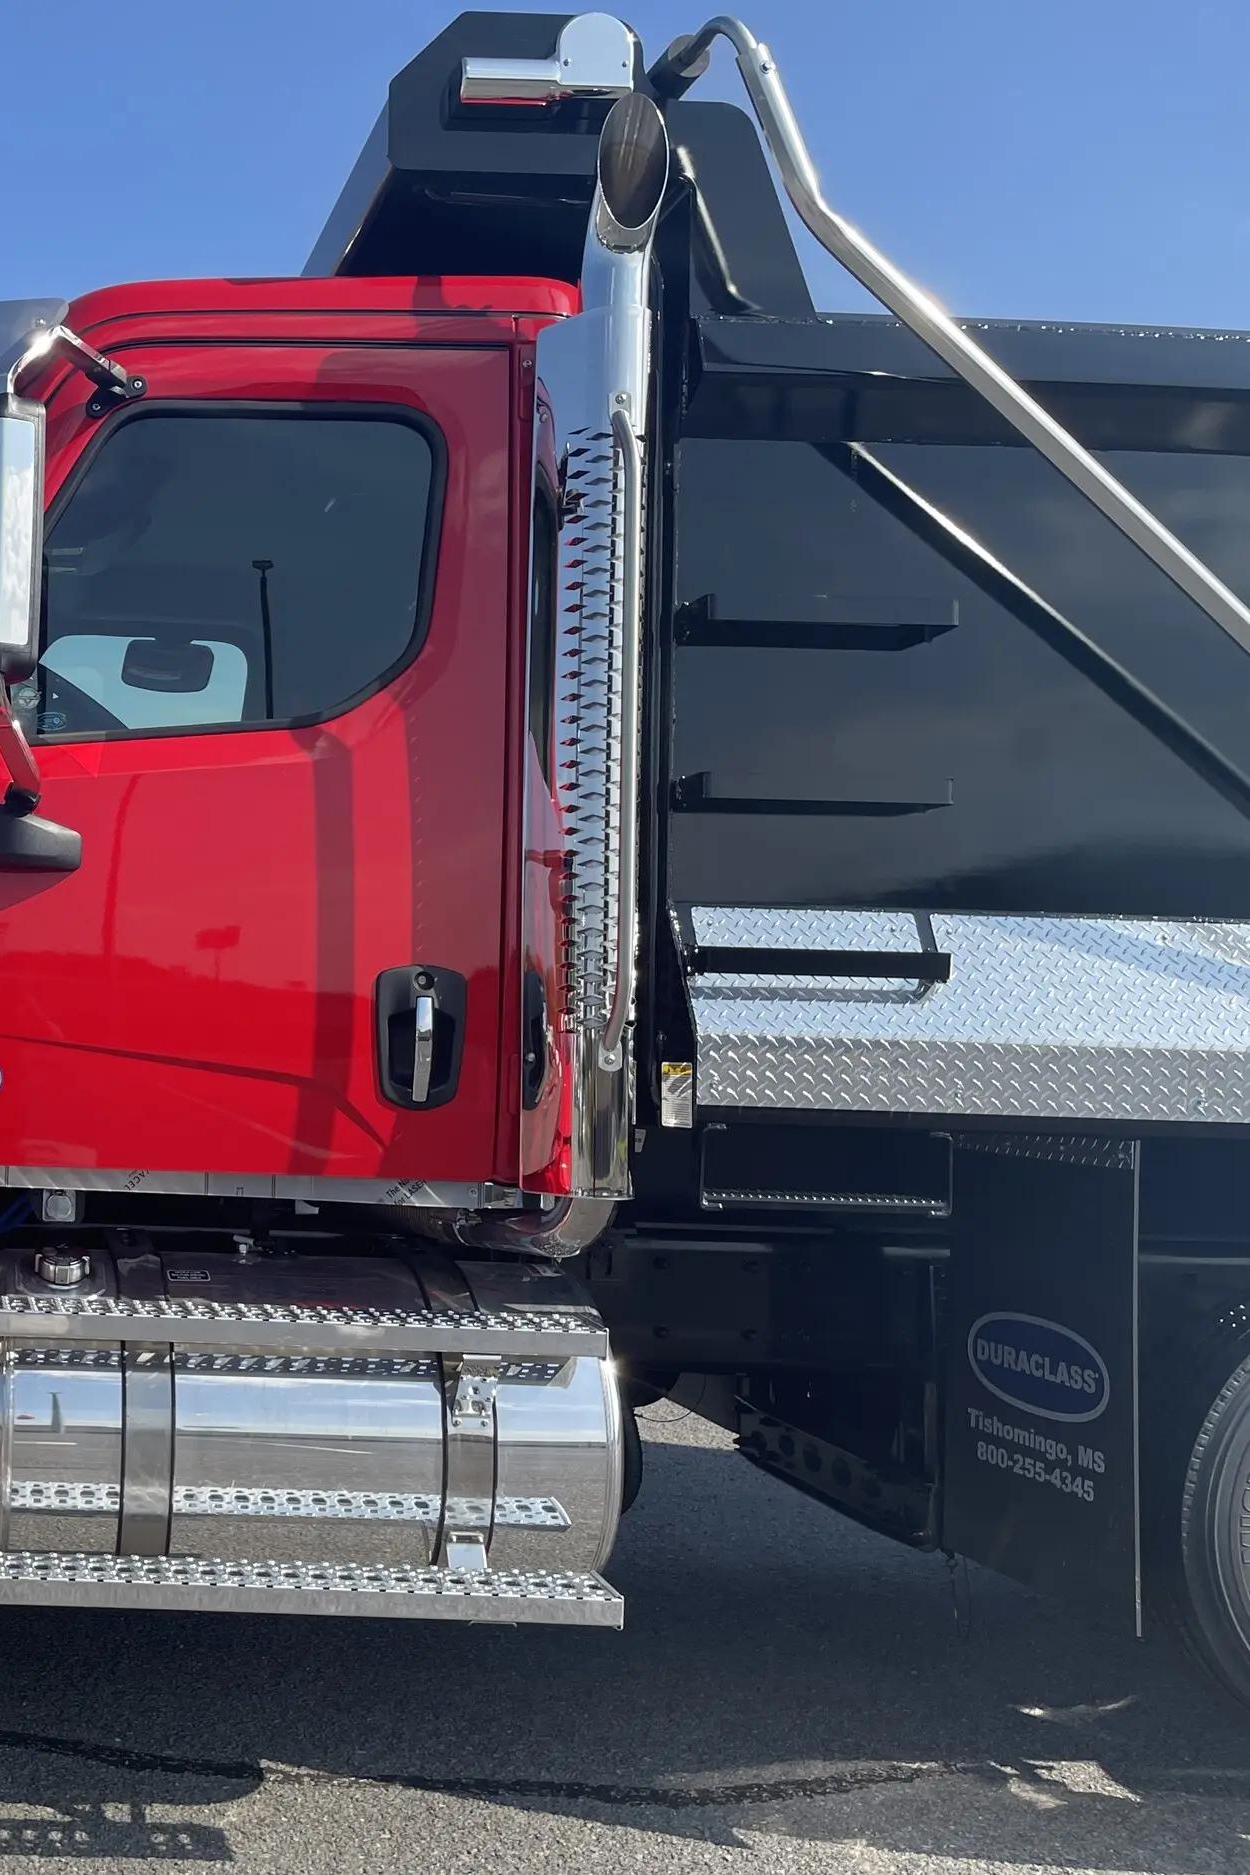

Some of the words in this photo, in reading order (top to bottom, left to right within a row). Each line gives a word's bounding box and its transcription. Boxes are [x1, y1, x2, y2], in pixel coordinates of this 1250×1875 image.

[976, 1337, 1097, 1394] DURACLASS
[967, 1407, 1072, 1467] Tishomingo,
[1077, 1444, 1106, 1474] MS
[976, 1440, 1095, 1502] 800-255-4345
